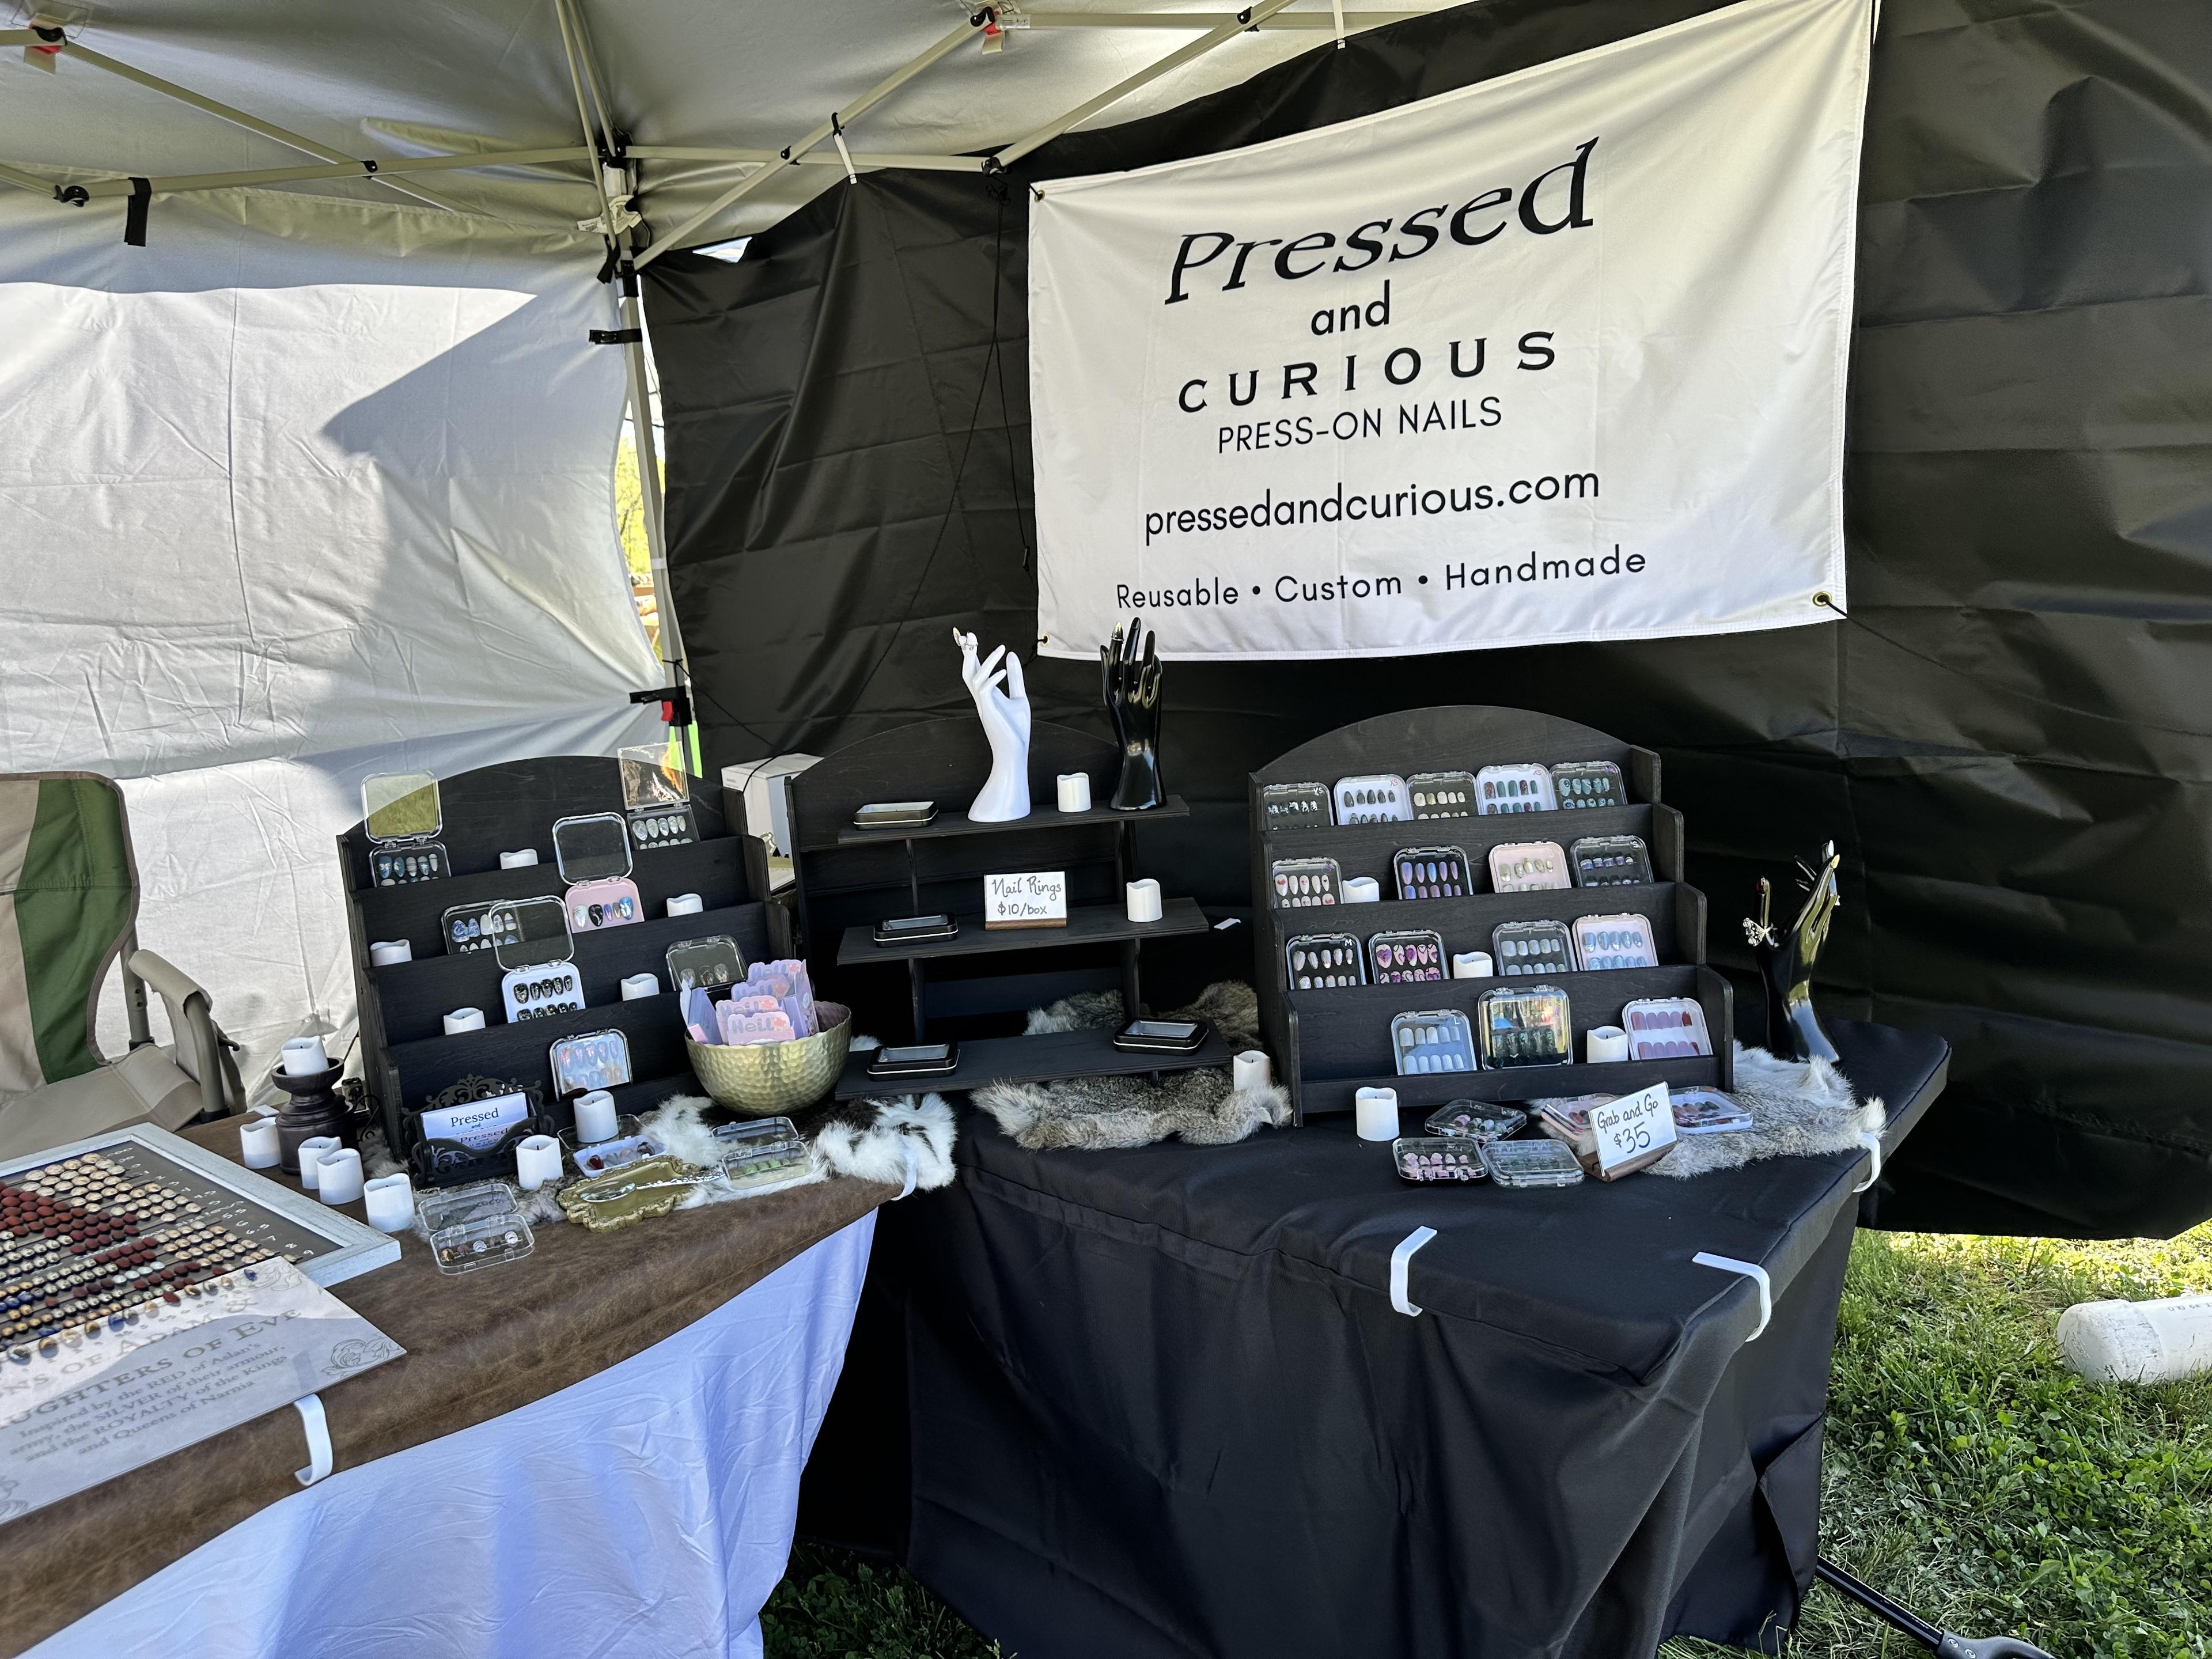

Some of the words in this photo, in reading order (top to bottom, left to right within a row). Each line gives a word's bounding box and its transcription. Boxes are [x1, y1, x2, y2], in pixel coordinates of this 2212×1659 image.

[1164, 136, 1600, 305] Pressed
[1310, 279, 1391, 336] and
[1178, 331, 1555, 414] CURIOUS
[1218, 408, 1381, 454] PRESS-ON
[1399, 396, 1502, 435] NAILS
[1145, 472, 1599, 547] pressedandcurious.com
[1116, 576, 1239, 609] Reusable
[1274, 574, 1402, 603] Custom
[1445, 543, 1646, 591] Handmade
[1389, 779, 1398, 787] XS
[991, 877, 1022, 897] Nail
[1027, 875, 1062, 901] Rings
[998, 901, 1047, 916] $10/box
[450, 1108, 499, 1127] Pressed
[460, 1127, 508, 1143] Pressed
[1597, 1109, 1620, 1134] Grab
[1622, 1100, 1642, 1120] and
[1644, 1093, 1658, 1116] Go
[1613, 1122, 1651, 1154] $35
[245, 1223, 270, 1234] 6.5
[0, 1358, 173, 1429] UGHTERS
[183, 1338, 222, 1358] OF
[19, 1407, 88, 1438] Inspired
[91, 1400, 113, 1411] by
[118, 1388, 144, 1400] the
[147, 1371, 185, 1389] RED
[191, 1361, 207, 1373] of
[212, 1343, 260, 1366] Aslan's
[61, 1354, 102, 1374] OF
[64, 1421, 92, 1434] the
[94, 1391, 162, 1421] SILVER
[166, 1382, 183, 1395] of
[186, 1370, 222, 1387] their
[78, 1437, 111, 1456] and
[113, 1412, 177, 1439] Queens
[181, 1400, 196, 1413] of
[202, 1381, 255, 1406] Narnia
[93, 1392, 190, 1435] ROYALTY
[196, 1382, 212, 1395] of
[215, 1374, 239, 1387] the
[243, 1354, 287, 1376] Kings
